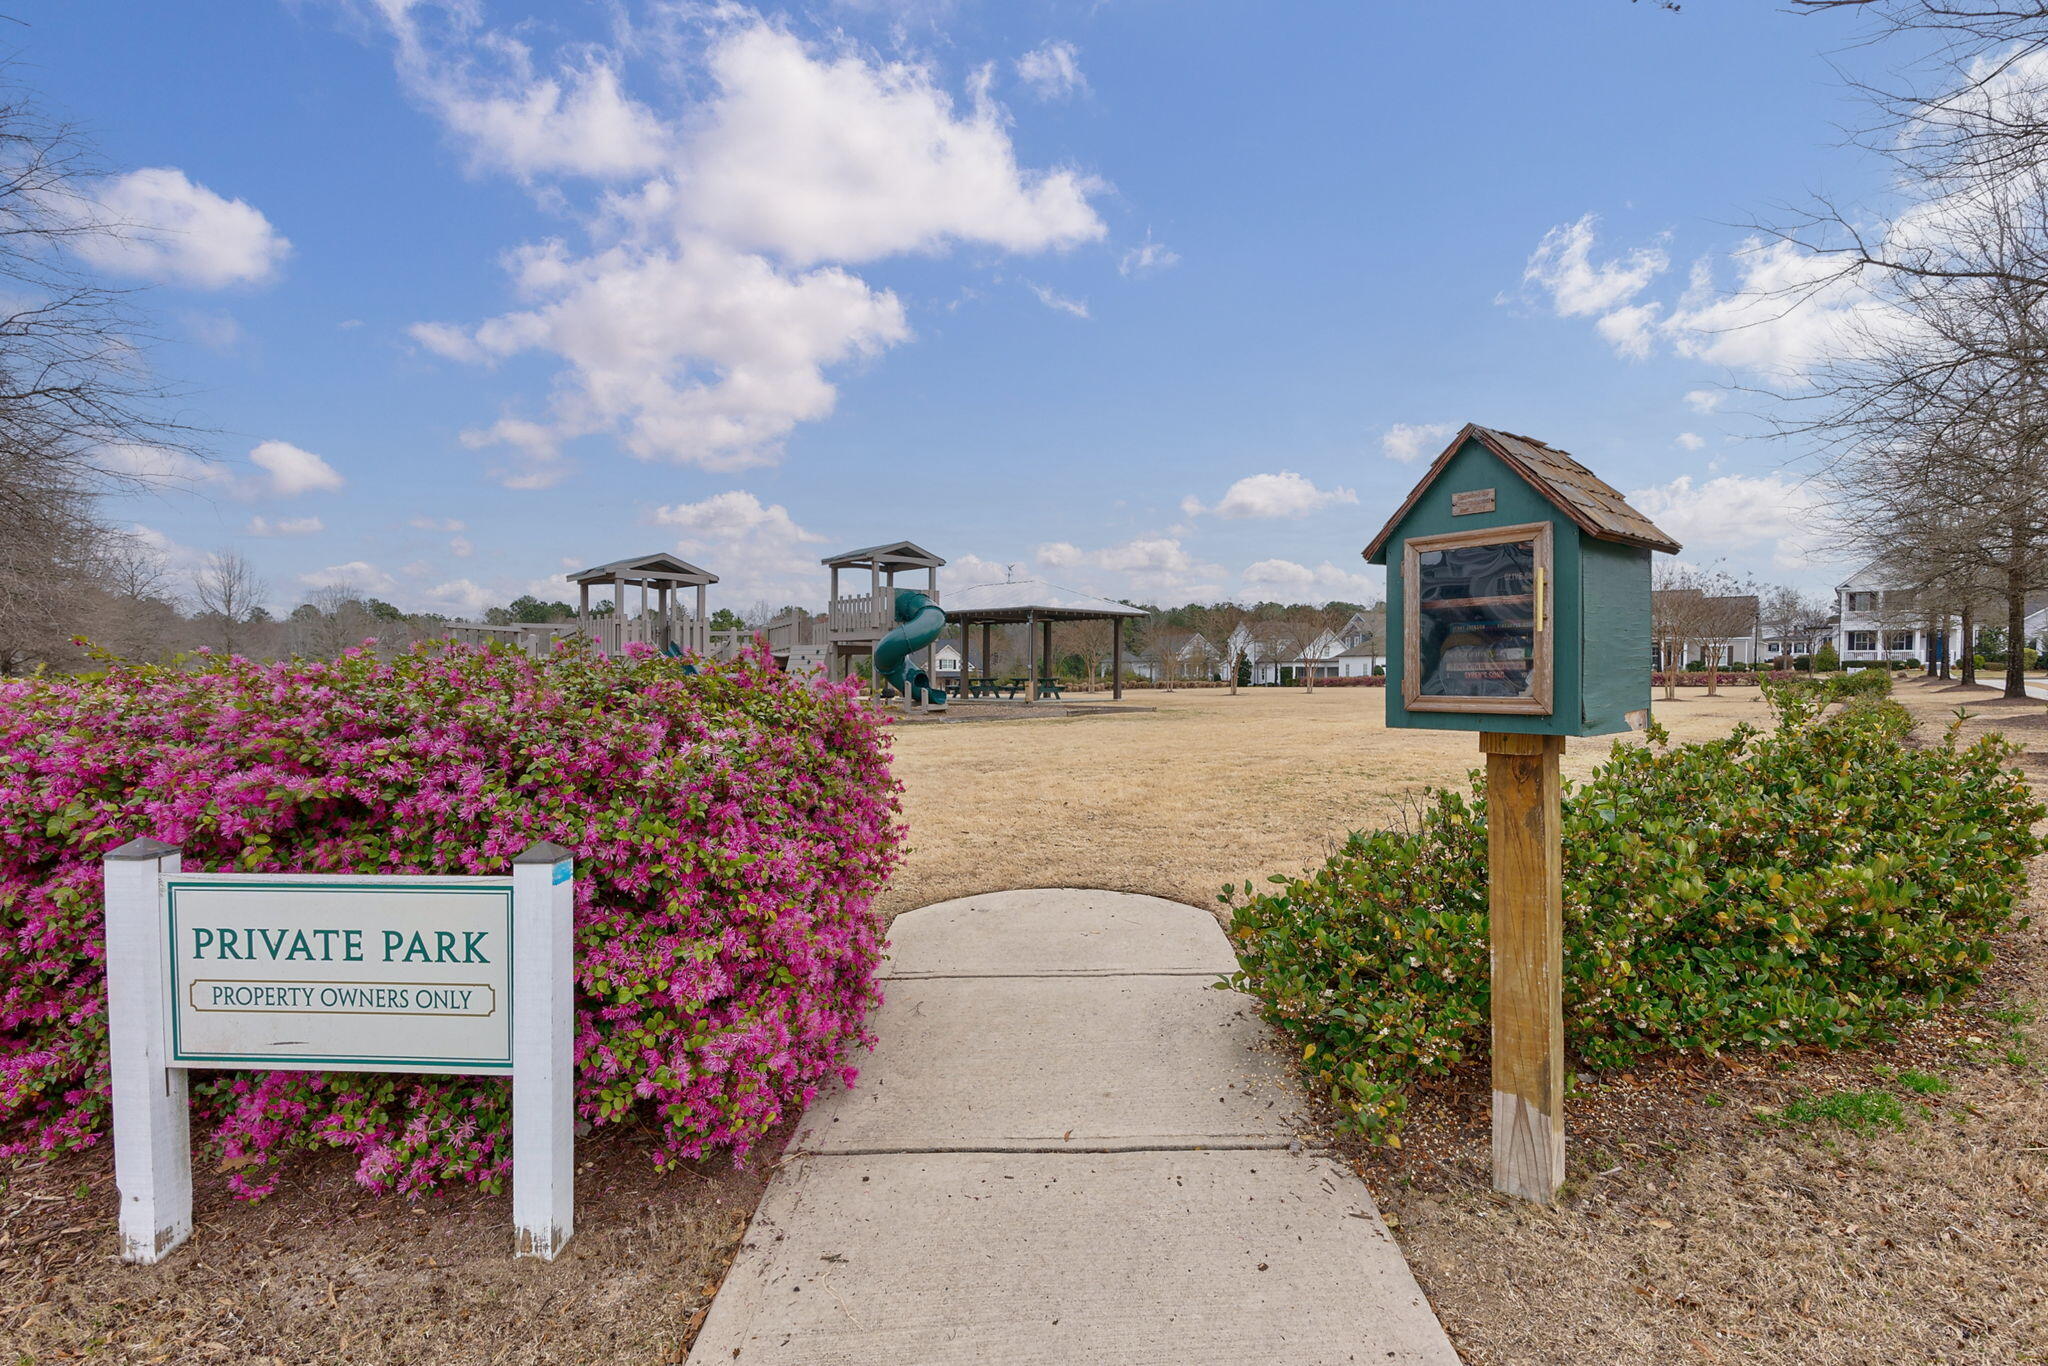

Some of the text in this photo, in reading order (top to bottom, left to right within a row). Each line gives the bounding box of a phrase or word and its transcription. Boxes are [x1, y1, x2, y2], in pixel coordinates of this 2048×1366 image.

[192, 928, 490, 963] PRIVATE PARK
[212, 987, 472, 1009] PROPERTY OWNERS ONLY
